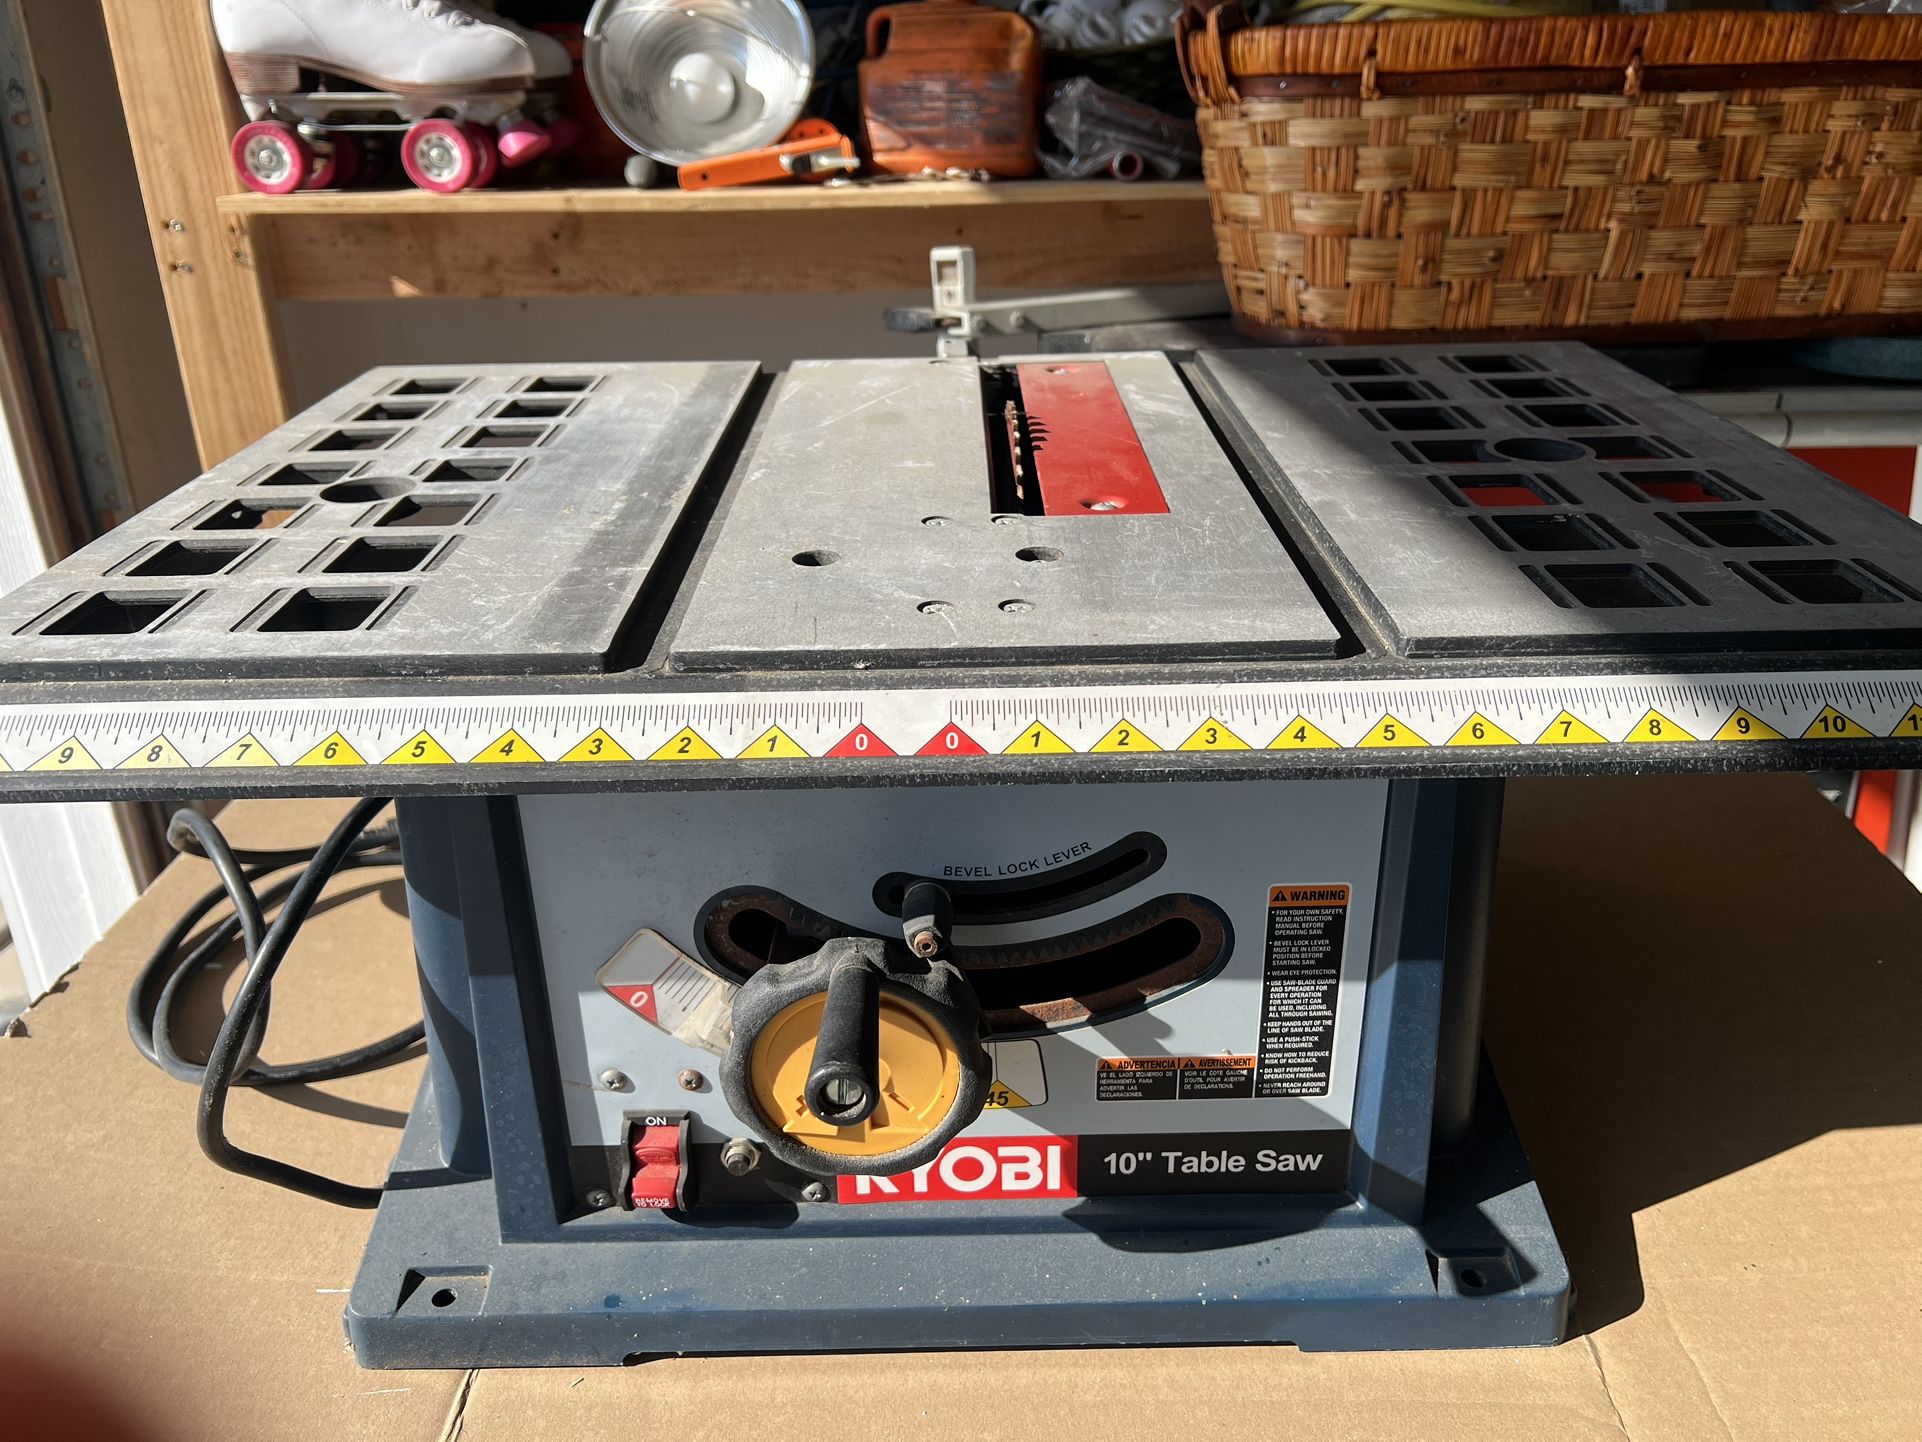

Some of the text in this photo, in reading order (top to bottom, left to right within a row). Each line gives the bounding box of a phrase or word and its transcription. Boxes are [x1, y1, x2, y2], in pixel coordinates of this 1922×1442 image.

[57, 713, 1922, 764] 9 8 7 6 5 4 3 2 1 0 0 1 2 3 4 5 6 7 8 9 10 1
[943, 842, 1092, 877] BEVEL LOCK LEVER
[1290, 890, 1345, 901] WARNING
[630, 990, 648, 1008] 0
[1117, 1060, 1175, 1069] ADVERTENCIA
[1198, 1058, 1251, 1067] AVERTISSEMENT
[985, 1091, 1009, 1106] 45
[646, 1117, 667, 1125] ON
[1104, 1149, 1323, 1174] 10" Table Saw
